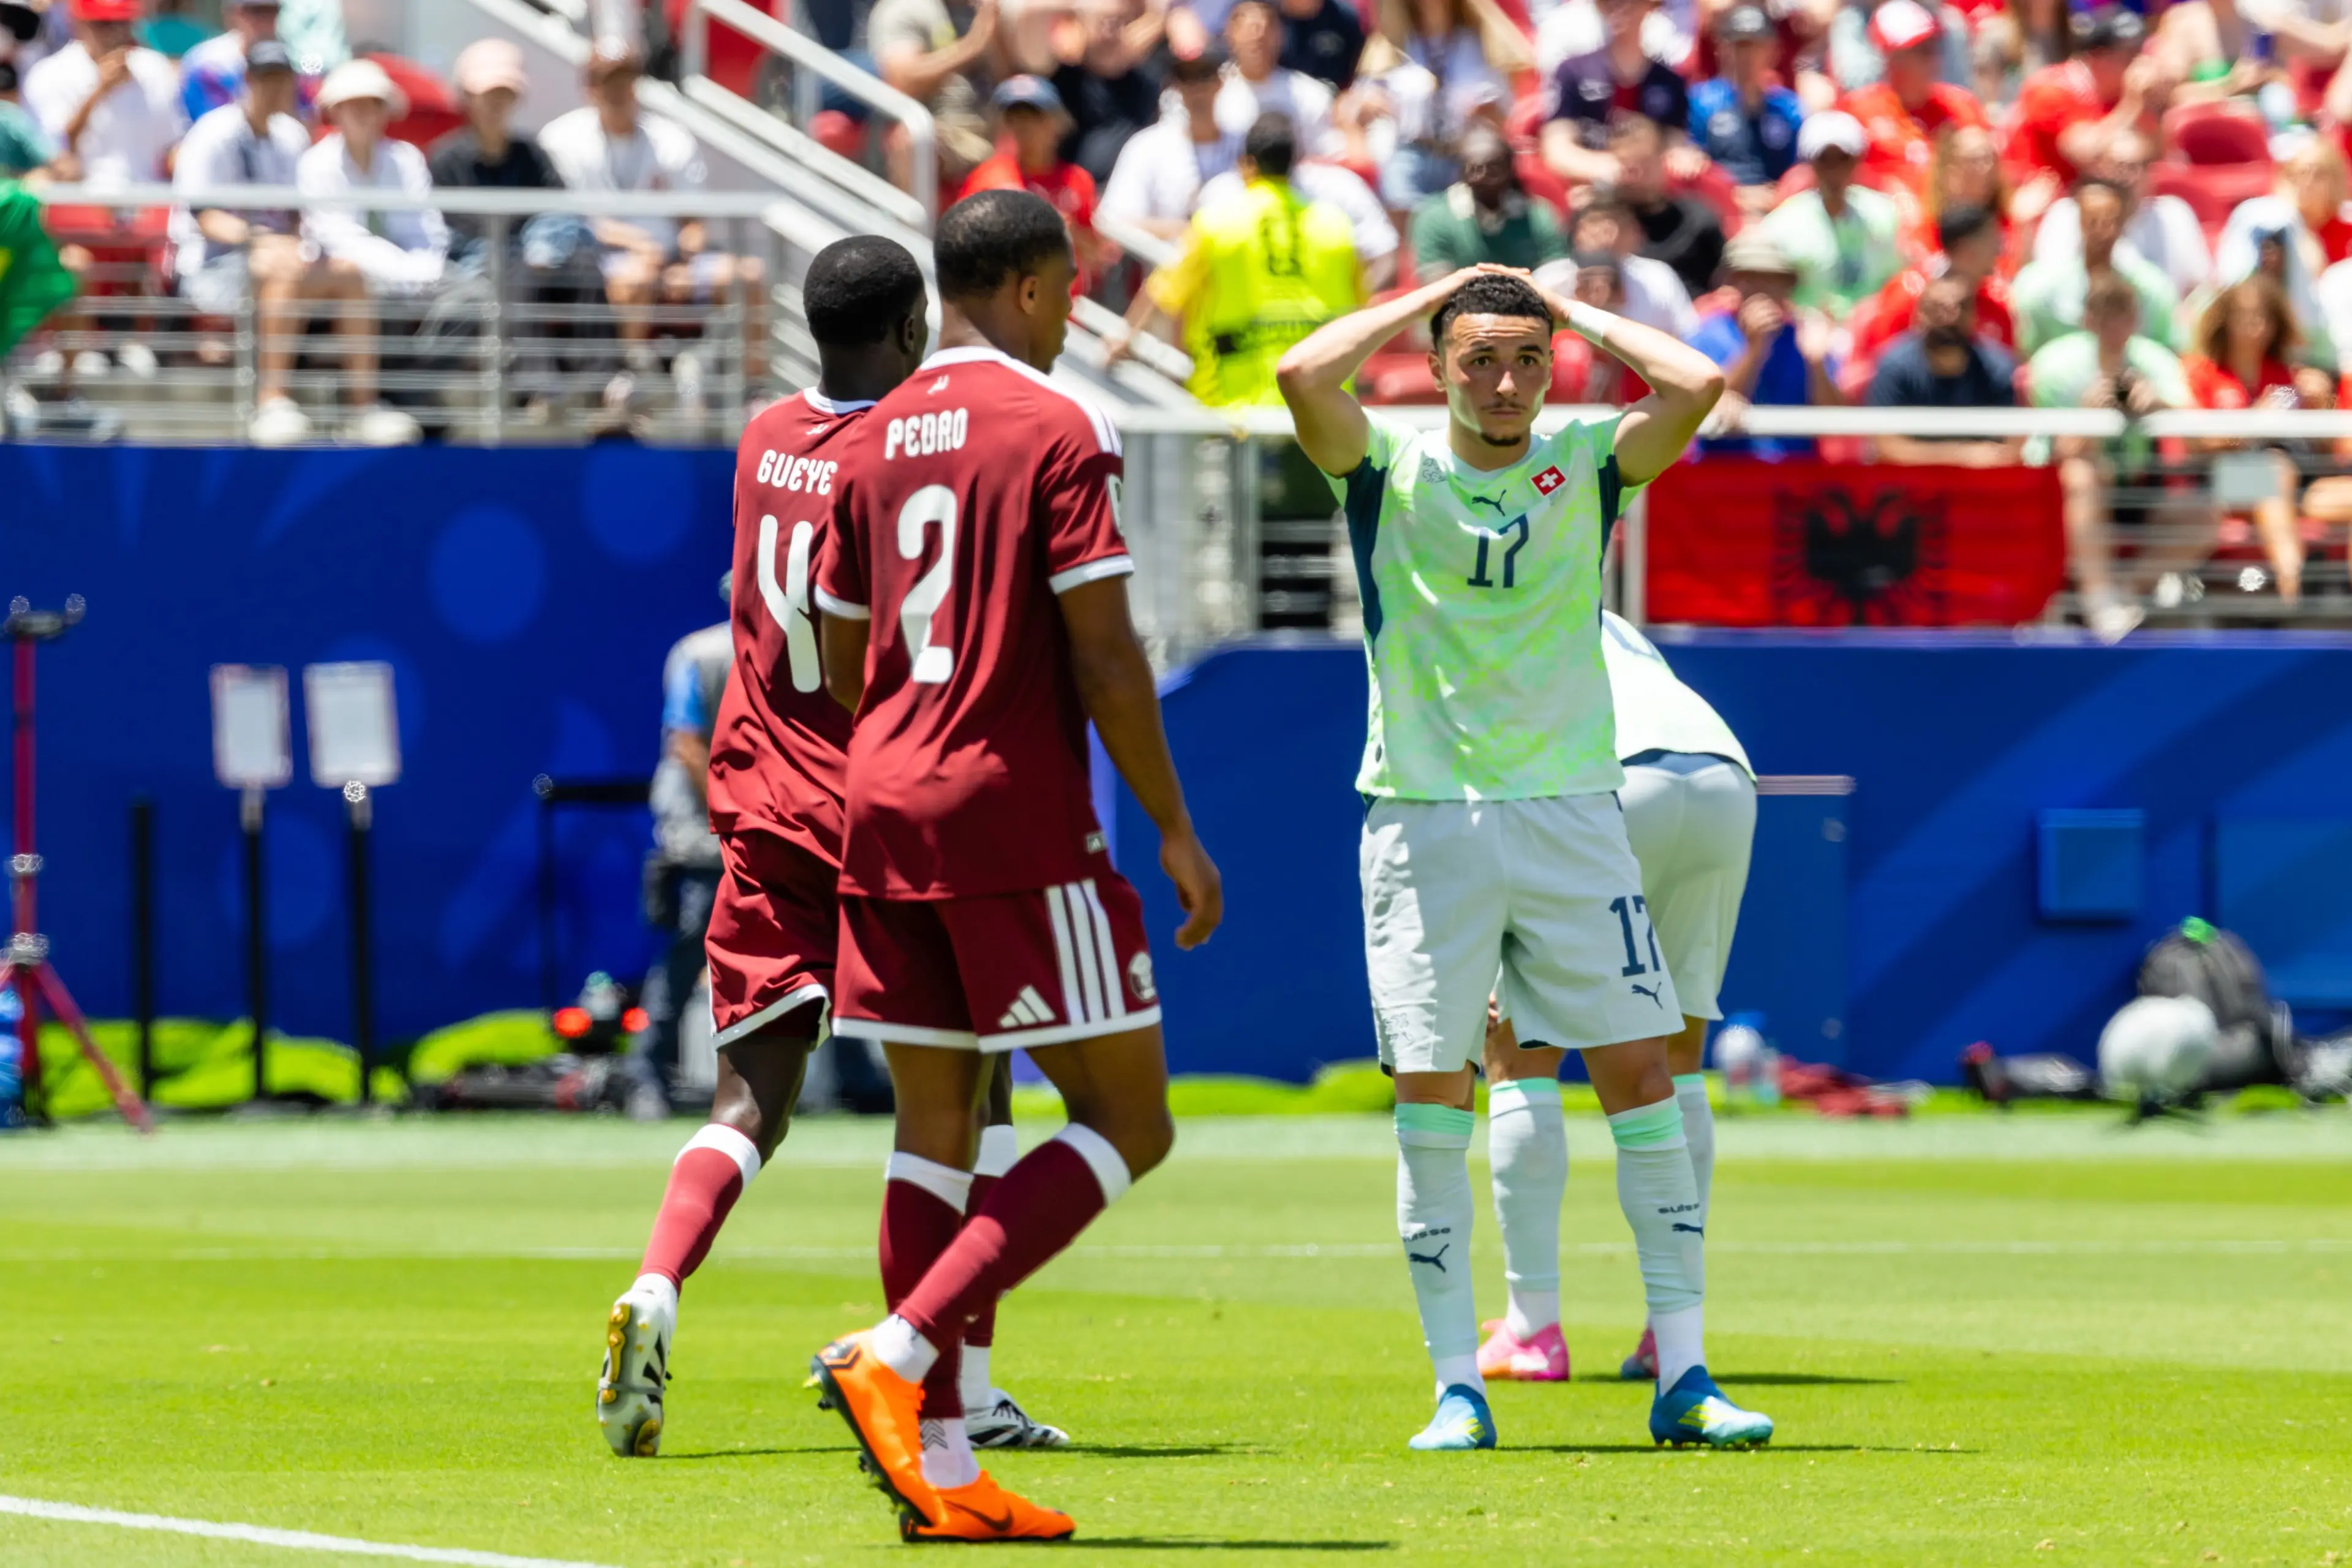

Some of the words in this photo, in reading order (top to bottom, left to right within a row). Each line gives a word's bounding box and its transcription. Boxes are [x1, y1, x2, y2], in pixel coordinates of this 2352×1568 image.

[884, 407, 968, 460] PEDRO
[757, 450, 838, 496] GUEYE
[897, 484, 957, 684] 2
[1467, 513, 1529, 588] 17
[757, 514, 821, 693] 4
